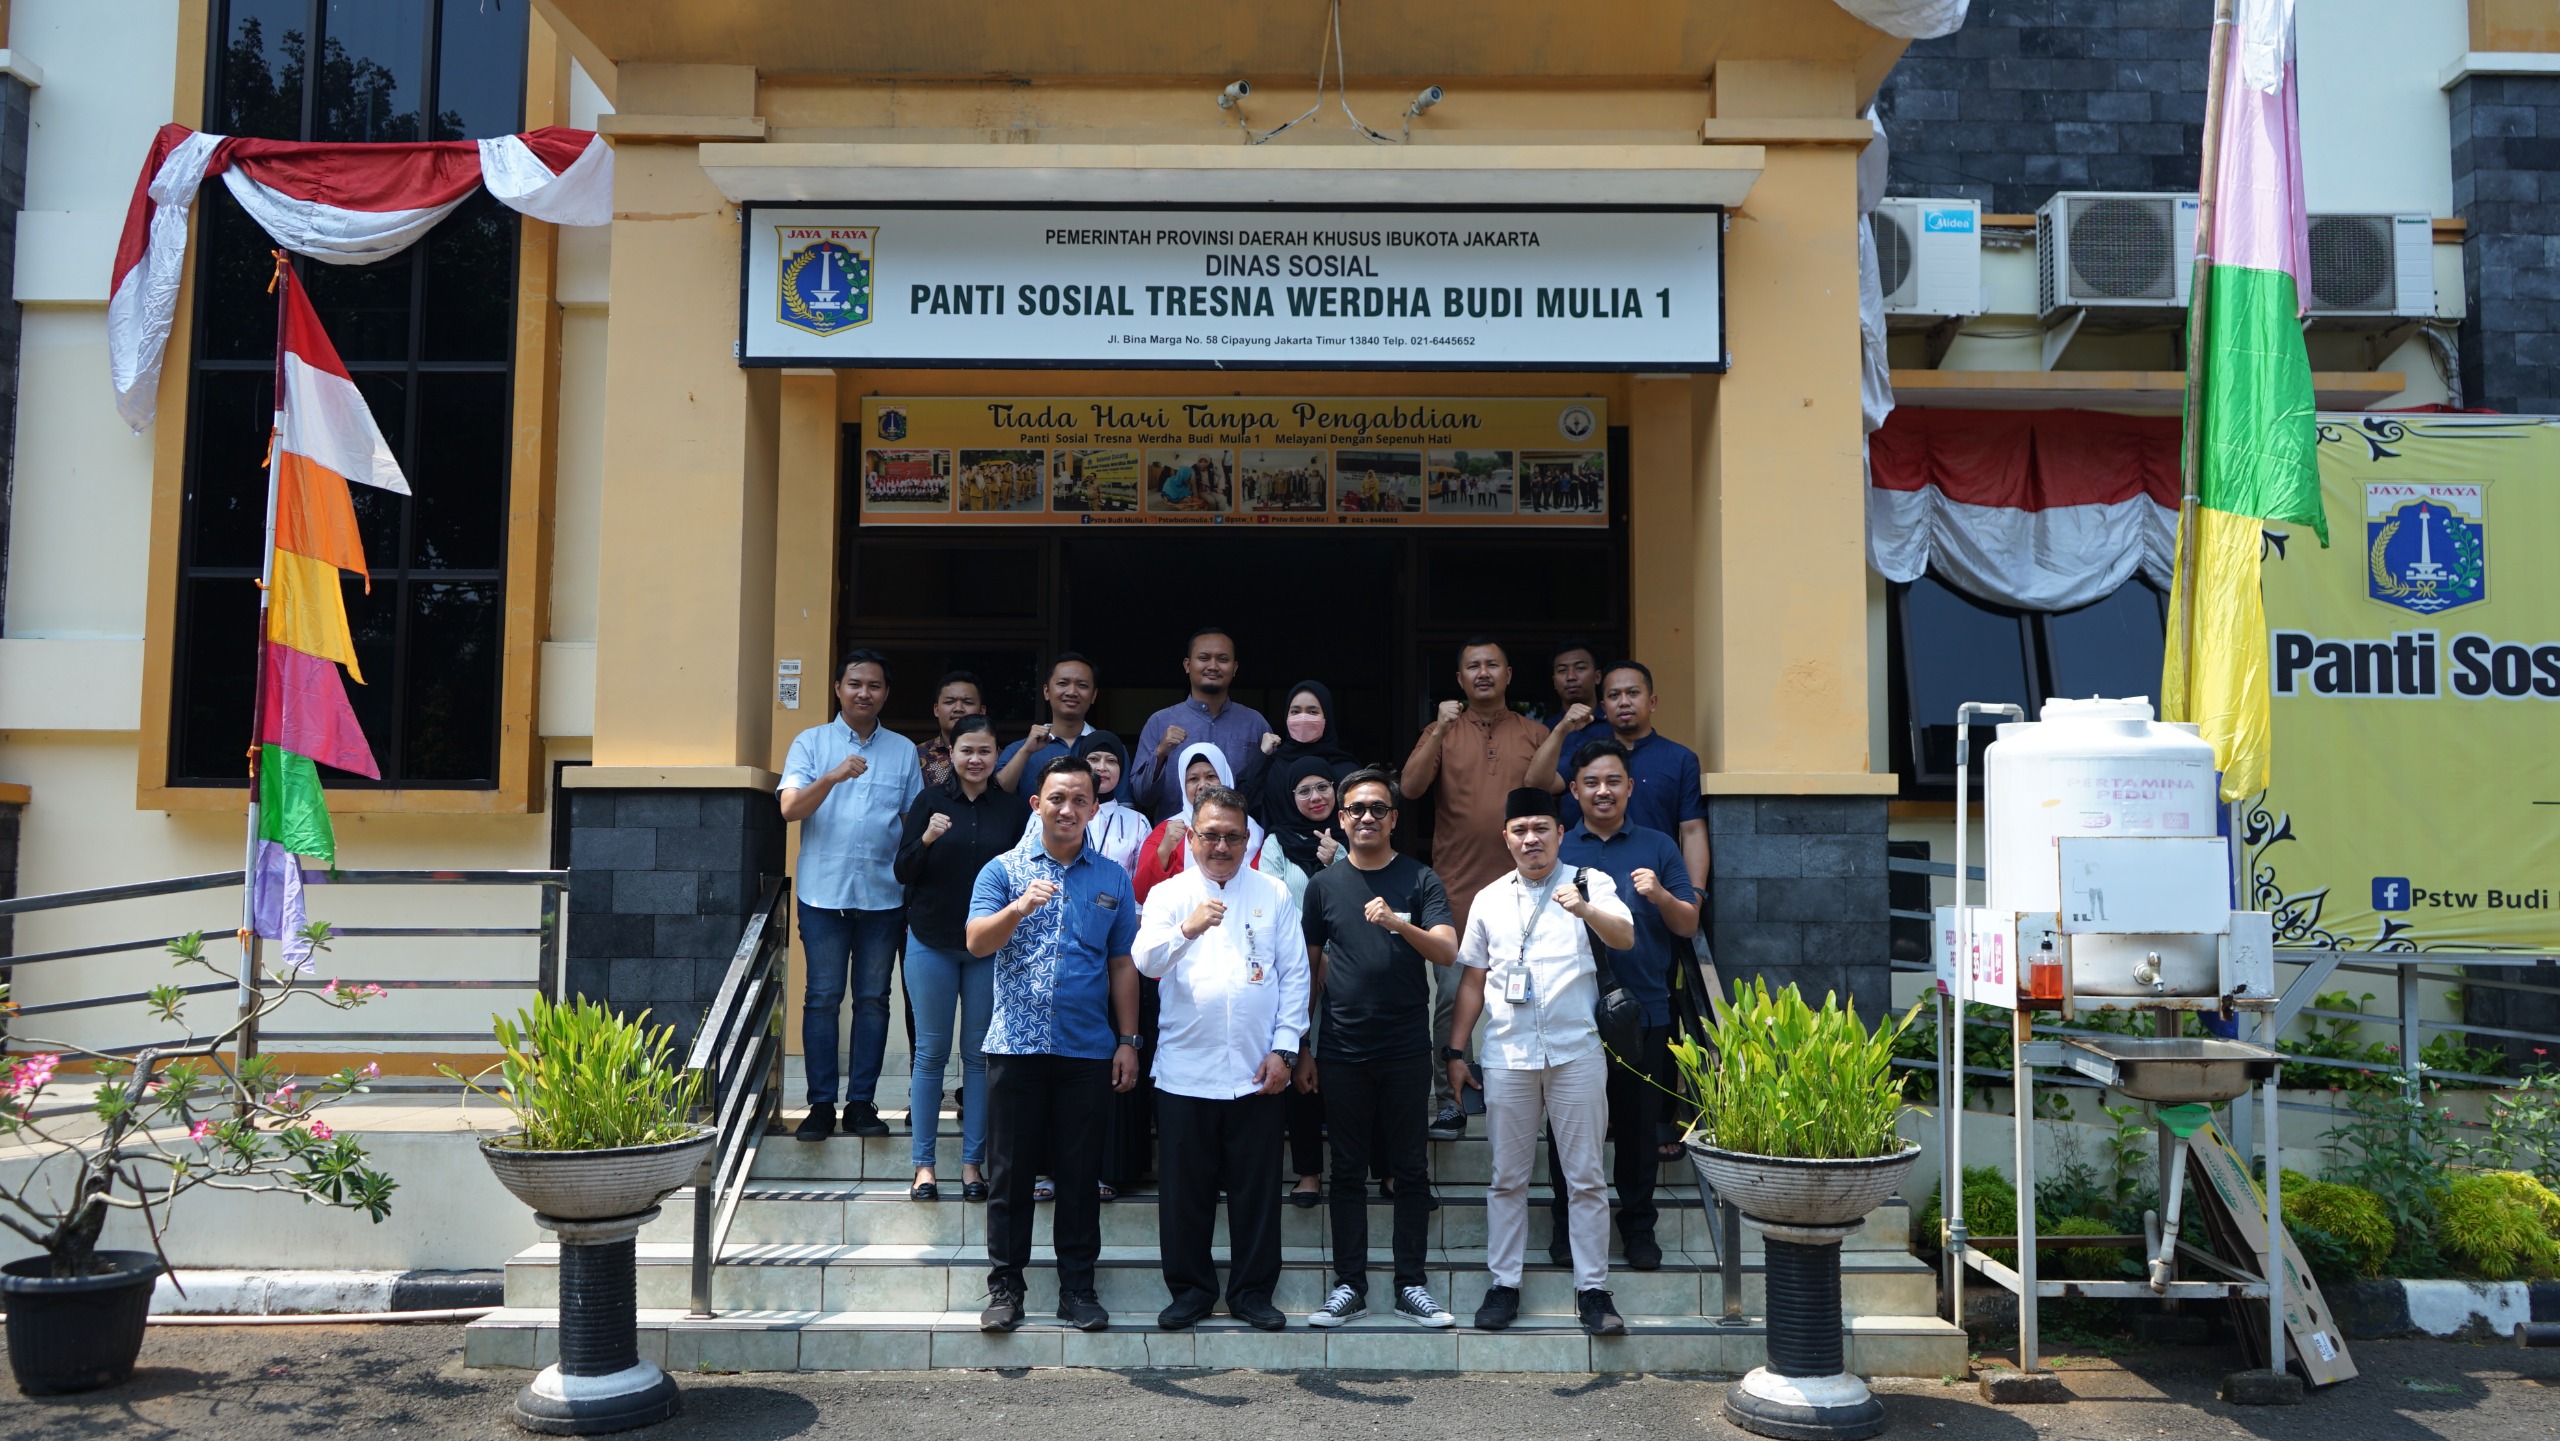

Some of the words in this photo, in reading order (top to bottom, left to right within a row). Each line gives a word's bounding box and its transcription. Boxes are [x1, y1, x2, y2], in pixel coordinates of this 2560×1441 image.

[1931, 214, 1969, 229] Midea
[788, 230, 822, 239] JAYA
[831, 230, 868, 239] RAYA
[1046, 229, 1151, 245] PEMERINTAH
[1156, 229, 1234, 246] PROVINSI
[1239, 231, 1309, 246] DAERAH
[1313, 231, 1382, 246] KHUSUS
[1386, 231, 1460, 247] IBUKOTA
[1463, 232, 1540, 247] JAKARTA
[1206, 254, 1281, 277] DINAS
[1288, 254, 1379, 277] SOSIAL
[910, 284, 1004, 315] PANTI
[1017, 284, 1134, 316] SOSIAL
[1145, 285, 1275, 317] TRESNA
[1287, 287, 1431, 317] WERDHA
[1444, 287, 1522, 318] BUDI
[1537, 287, 1643, 318] MULIA
[1655, 288, 1670, 318] 1
[1107, 335, 1120, 344] Jl.
[1123, 335, 1147, 344] Bina
[1150, 335, 1182, 347] Marga
[1185, 335, 1203, 345] No.
[1206, 336, 1219, 345] 58
[1221, 335, 1271, 347] Cipayung
[1274, 336, 1313, 345] Jakarta
[1316, 336, 1346, 345] Timur
[1349, 336, 1380, 346] 13840
[1382, 336, 1408, 348] Telp.
[1410, 336, 1476, 346] 021-6445652
[987, 404, 1078, 428] Tiada
[1090, 404, 1170, 428] Hari
[1182, 404, 1280, 434] Tanpa
[1292, 402, 1482, 435] Pengabdian
[1020, 434, 1050, 443] Panti
[1055, 434, 1088, 443] Sosial
[1094, 434, 1132, 443] Tresna
[1138, 434, 1182, 443] Werdha
[1188, 434, 1214, 443] Budi
[1219, 434, 1251, 443] Mulia
[1254, 434, 1260, 443] 1
[1275, 434, 1327, 446] Melayani
[1330, 434, 1373, 446] Dengan
[1376, 434, 1425, 446] Sepenuh
[1428, 434, 1452, 444] Hati
[2369, 486, 2415, 495] JAYA
[2430, 487, 2478, 496] RAYA
[2275, 633, 2436, 695] Panti
[2067, 778, 2195, 789] PERTAMINA
[2097, 790, 2174, 800] PEDULI
[2412, 888, 2478, 908] Pstw
[2487, 889, 2548, 909] Budi
